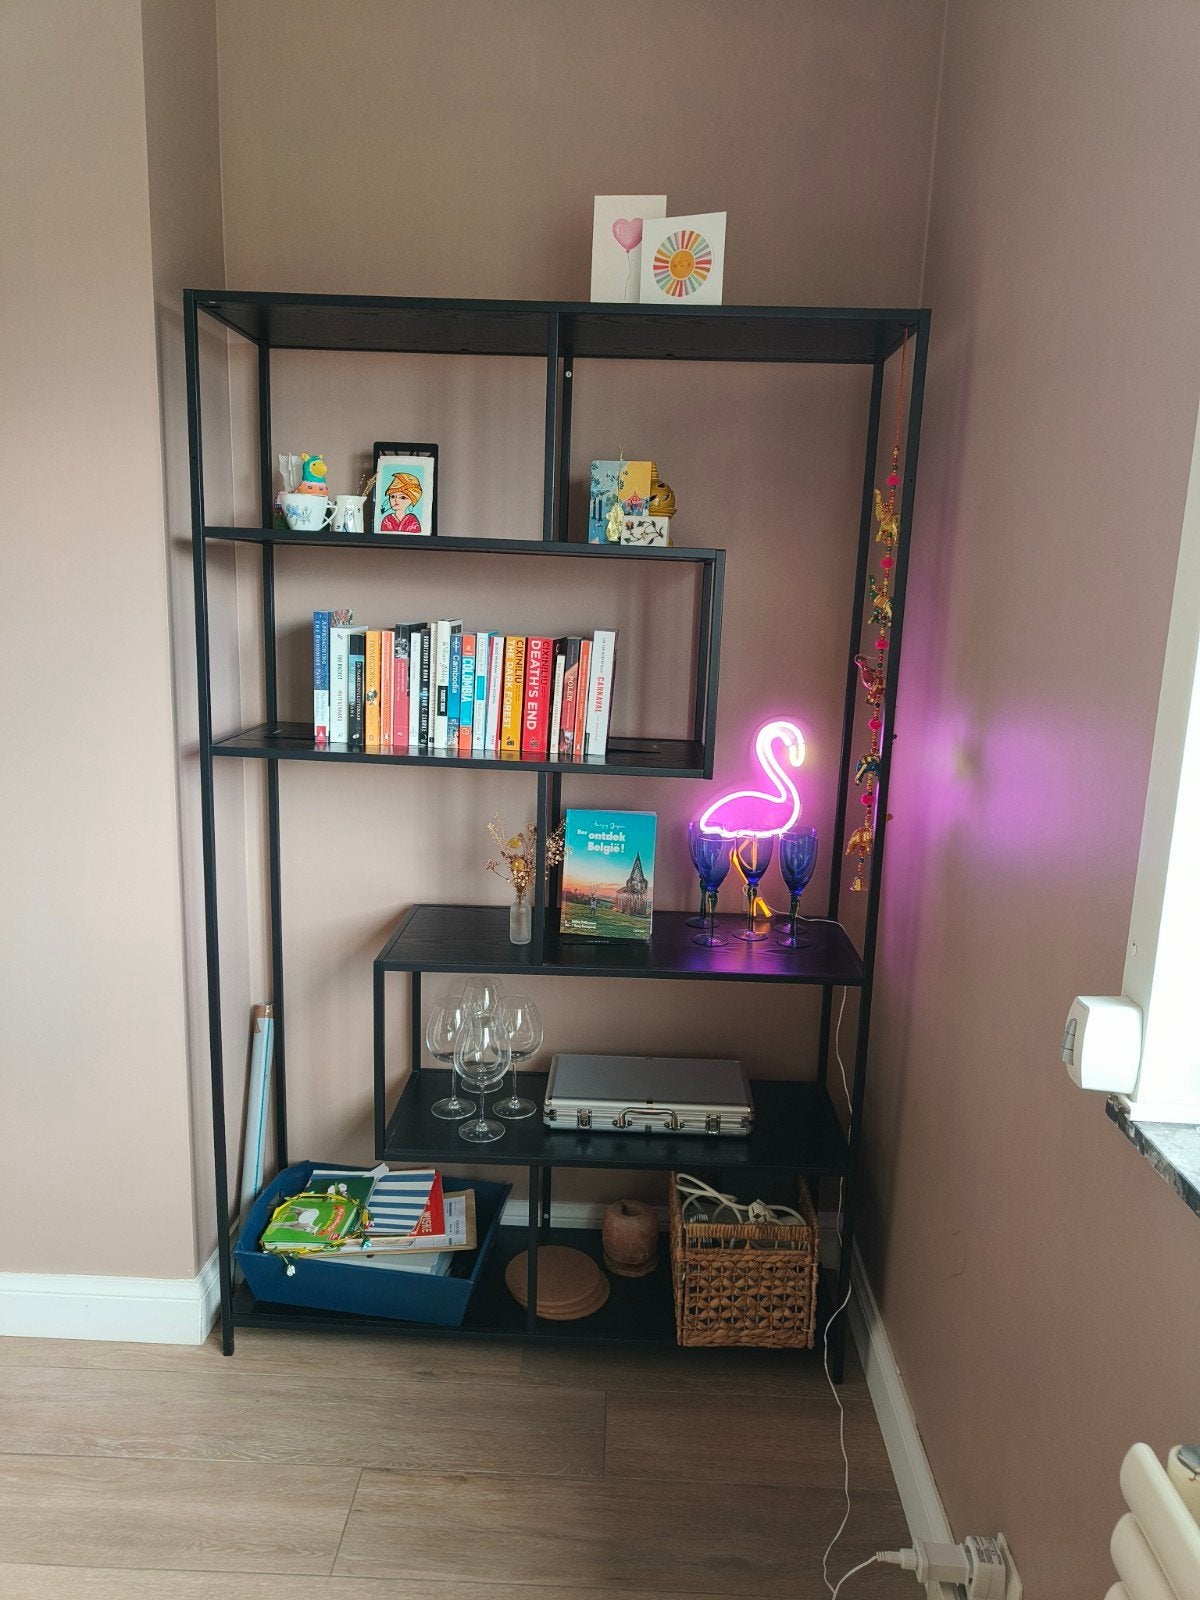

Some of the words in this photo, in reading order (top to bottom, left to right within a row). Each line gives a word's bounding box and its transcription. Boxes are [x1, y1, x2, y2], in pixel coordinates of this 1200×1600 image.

[507, 640, 515, 659] THE
[516, 640, 524, 666] CIXIN
[542, 641, 550, 667] CIXIN
[461, 657, 472, 702] COLOMBIA
[505, 662, 513, 688] DARK
[528, 640, 542, 698] DEATH'S
[594, 677, 605, 713] CARNAVAL
[503, 691, 512, 729] FOREST
[526, 702, 538, 730] END
[588, 832, 626, 841] ontdek
[588, 841, 620, 855] België
[422, 1211, 432, 1233] WISKE
